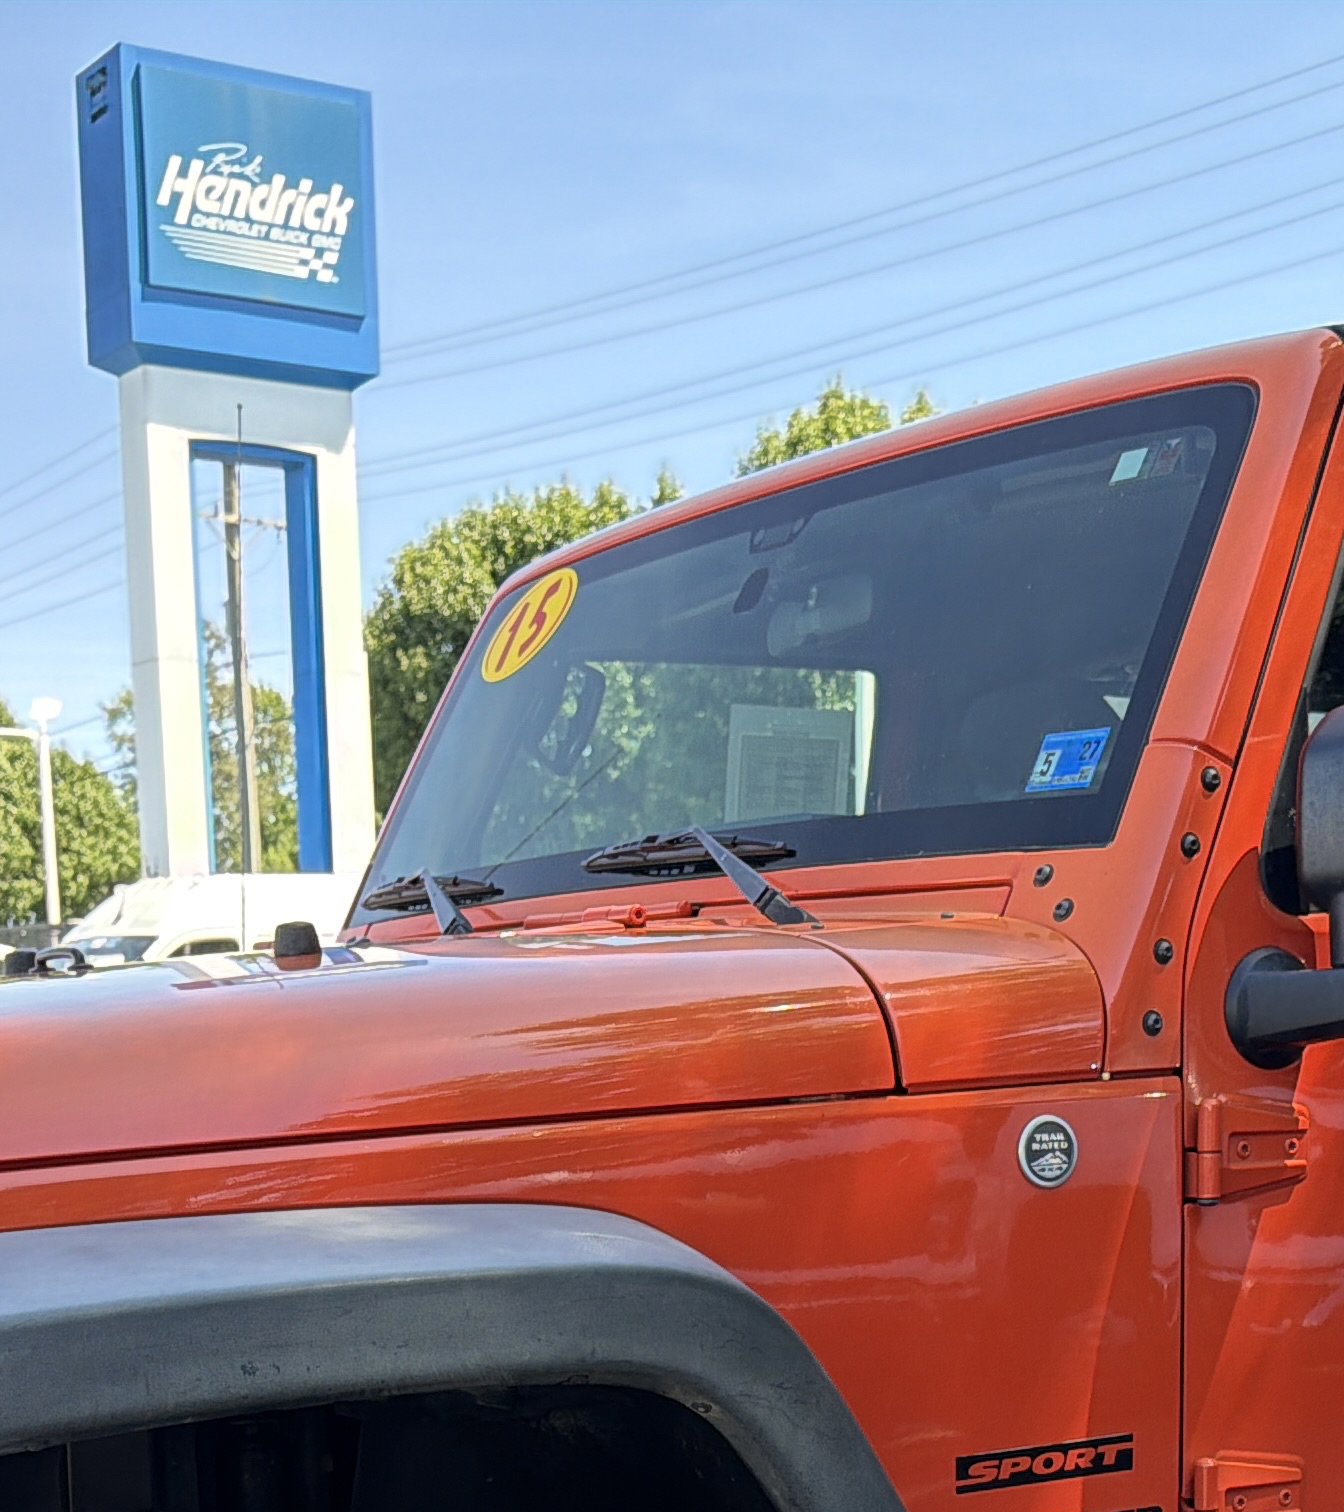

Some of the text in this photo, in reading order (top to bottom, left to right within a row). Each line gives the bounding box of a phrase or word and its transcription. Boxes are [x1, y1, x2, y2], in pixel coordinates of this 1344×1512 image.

[156, 153, 356, 236] Hendrick
[494, 577, 564, 674] 15
[1079, 740, 1102, 761] 27
[1039, 751, 1056, 777] 5
[1031, 1141, 1069, 1151] RATED
[1033, 1132, 1065, 1142] TRAIL
[956, 1445, 1133, 1489] SPORT
